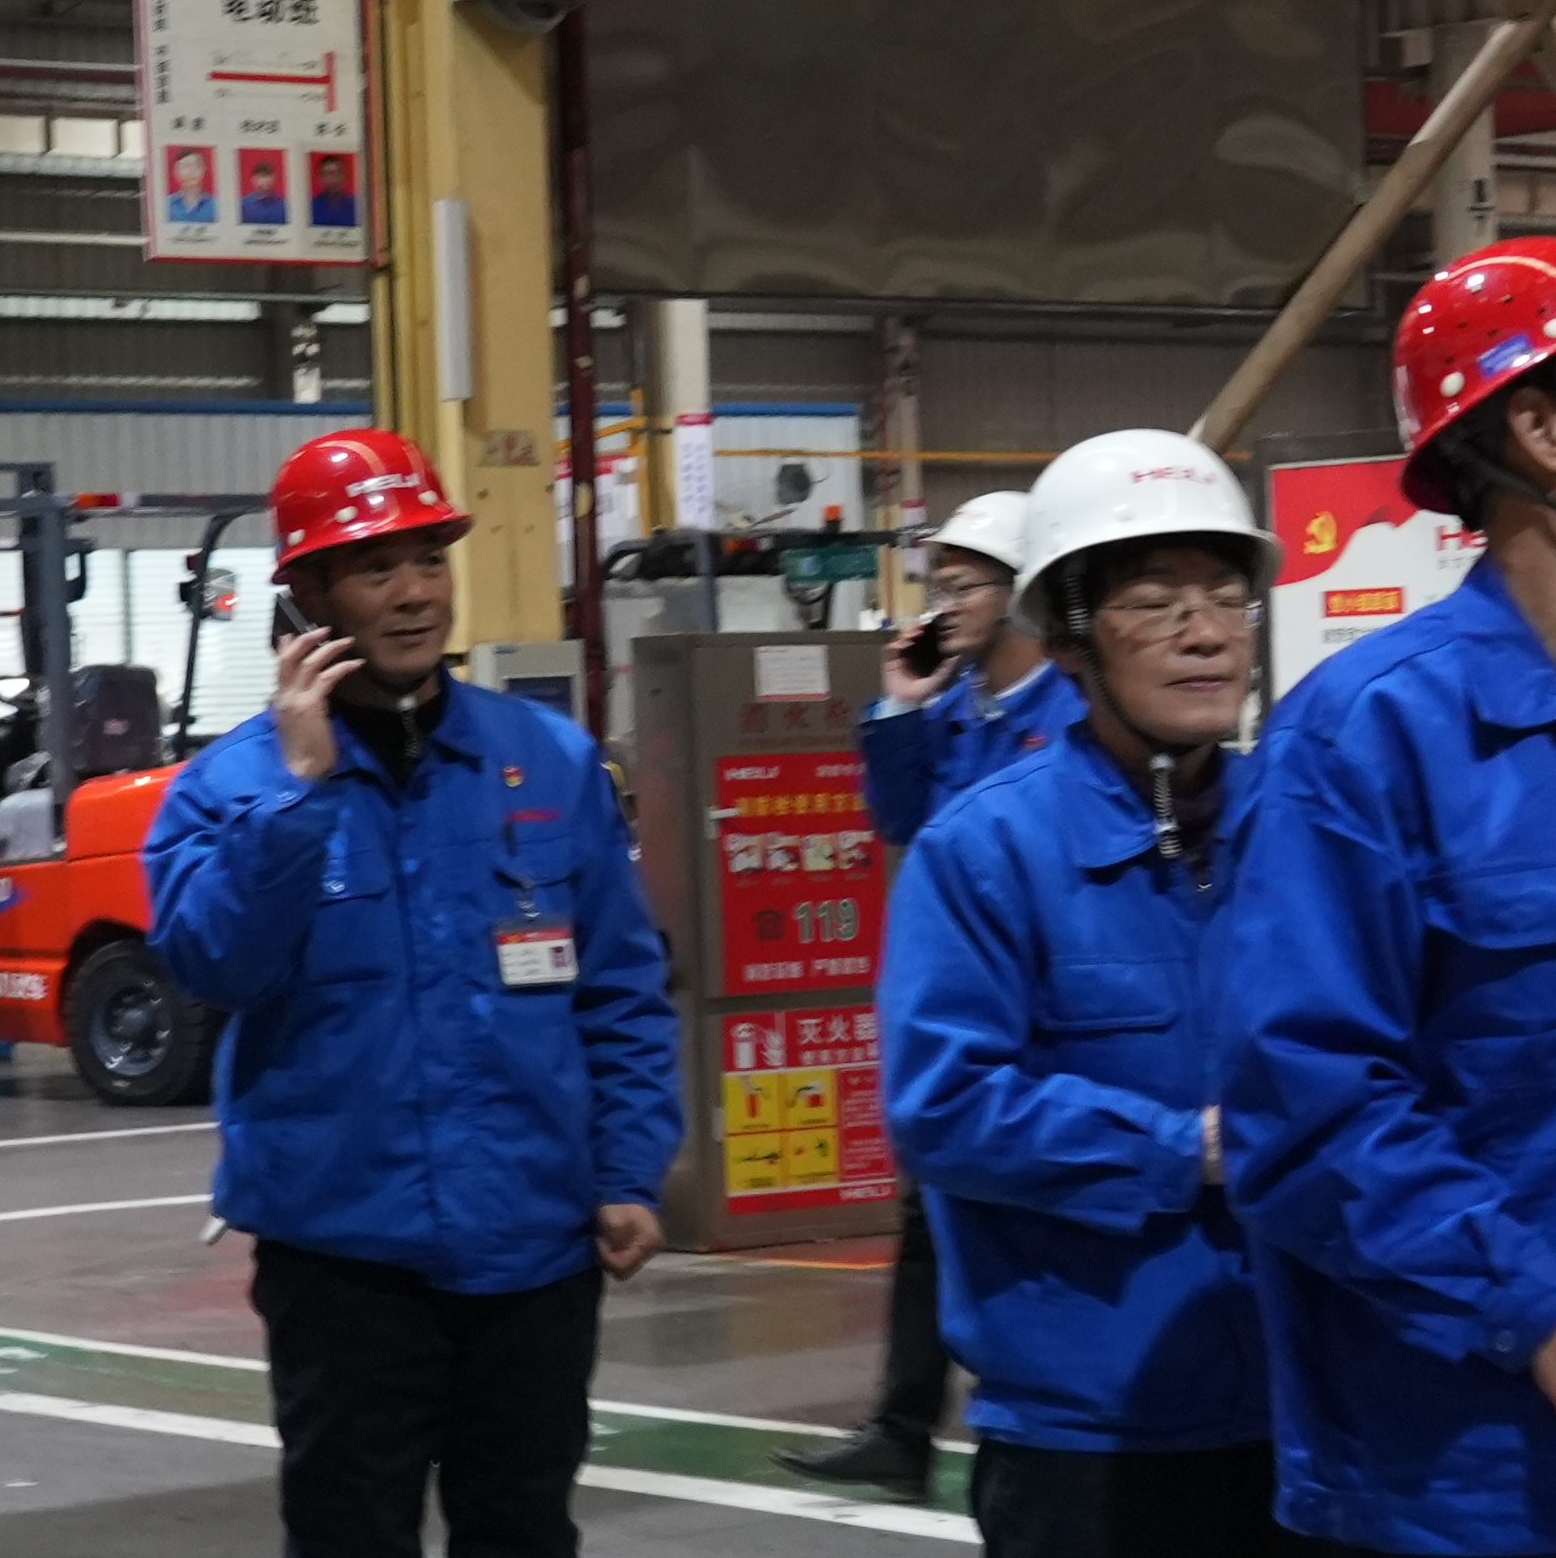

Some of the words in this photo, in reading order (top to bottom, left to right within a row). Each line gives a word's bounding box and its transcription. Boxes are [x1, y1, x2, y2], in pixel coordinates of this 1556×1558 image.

[347, 472, 420, 497] HELI
[794, 898, 859, 943] 119
[797, 1012, 879, 1045] 灭火器
